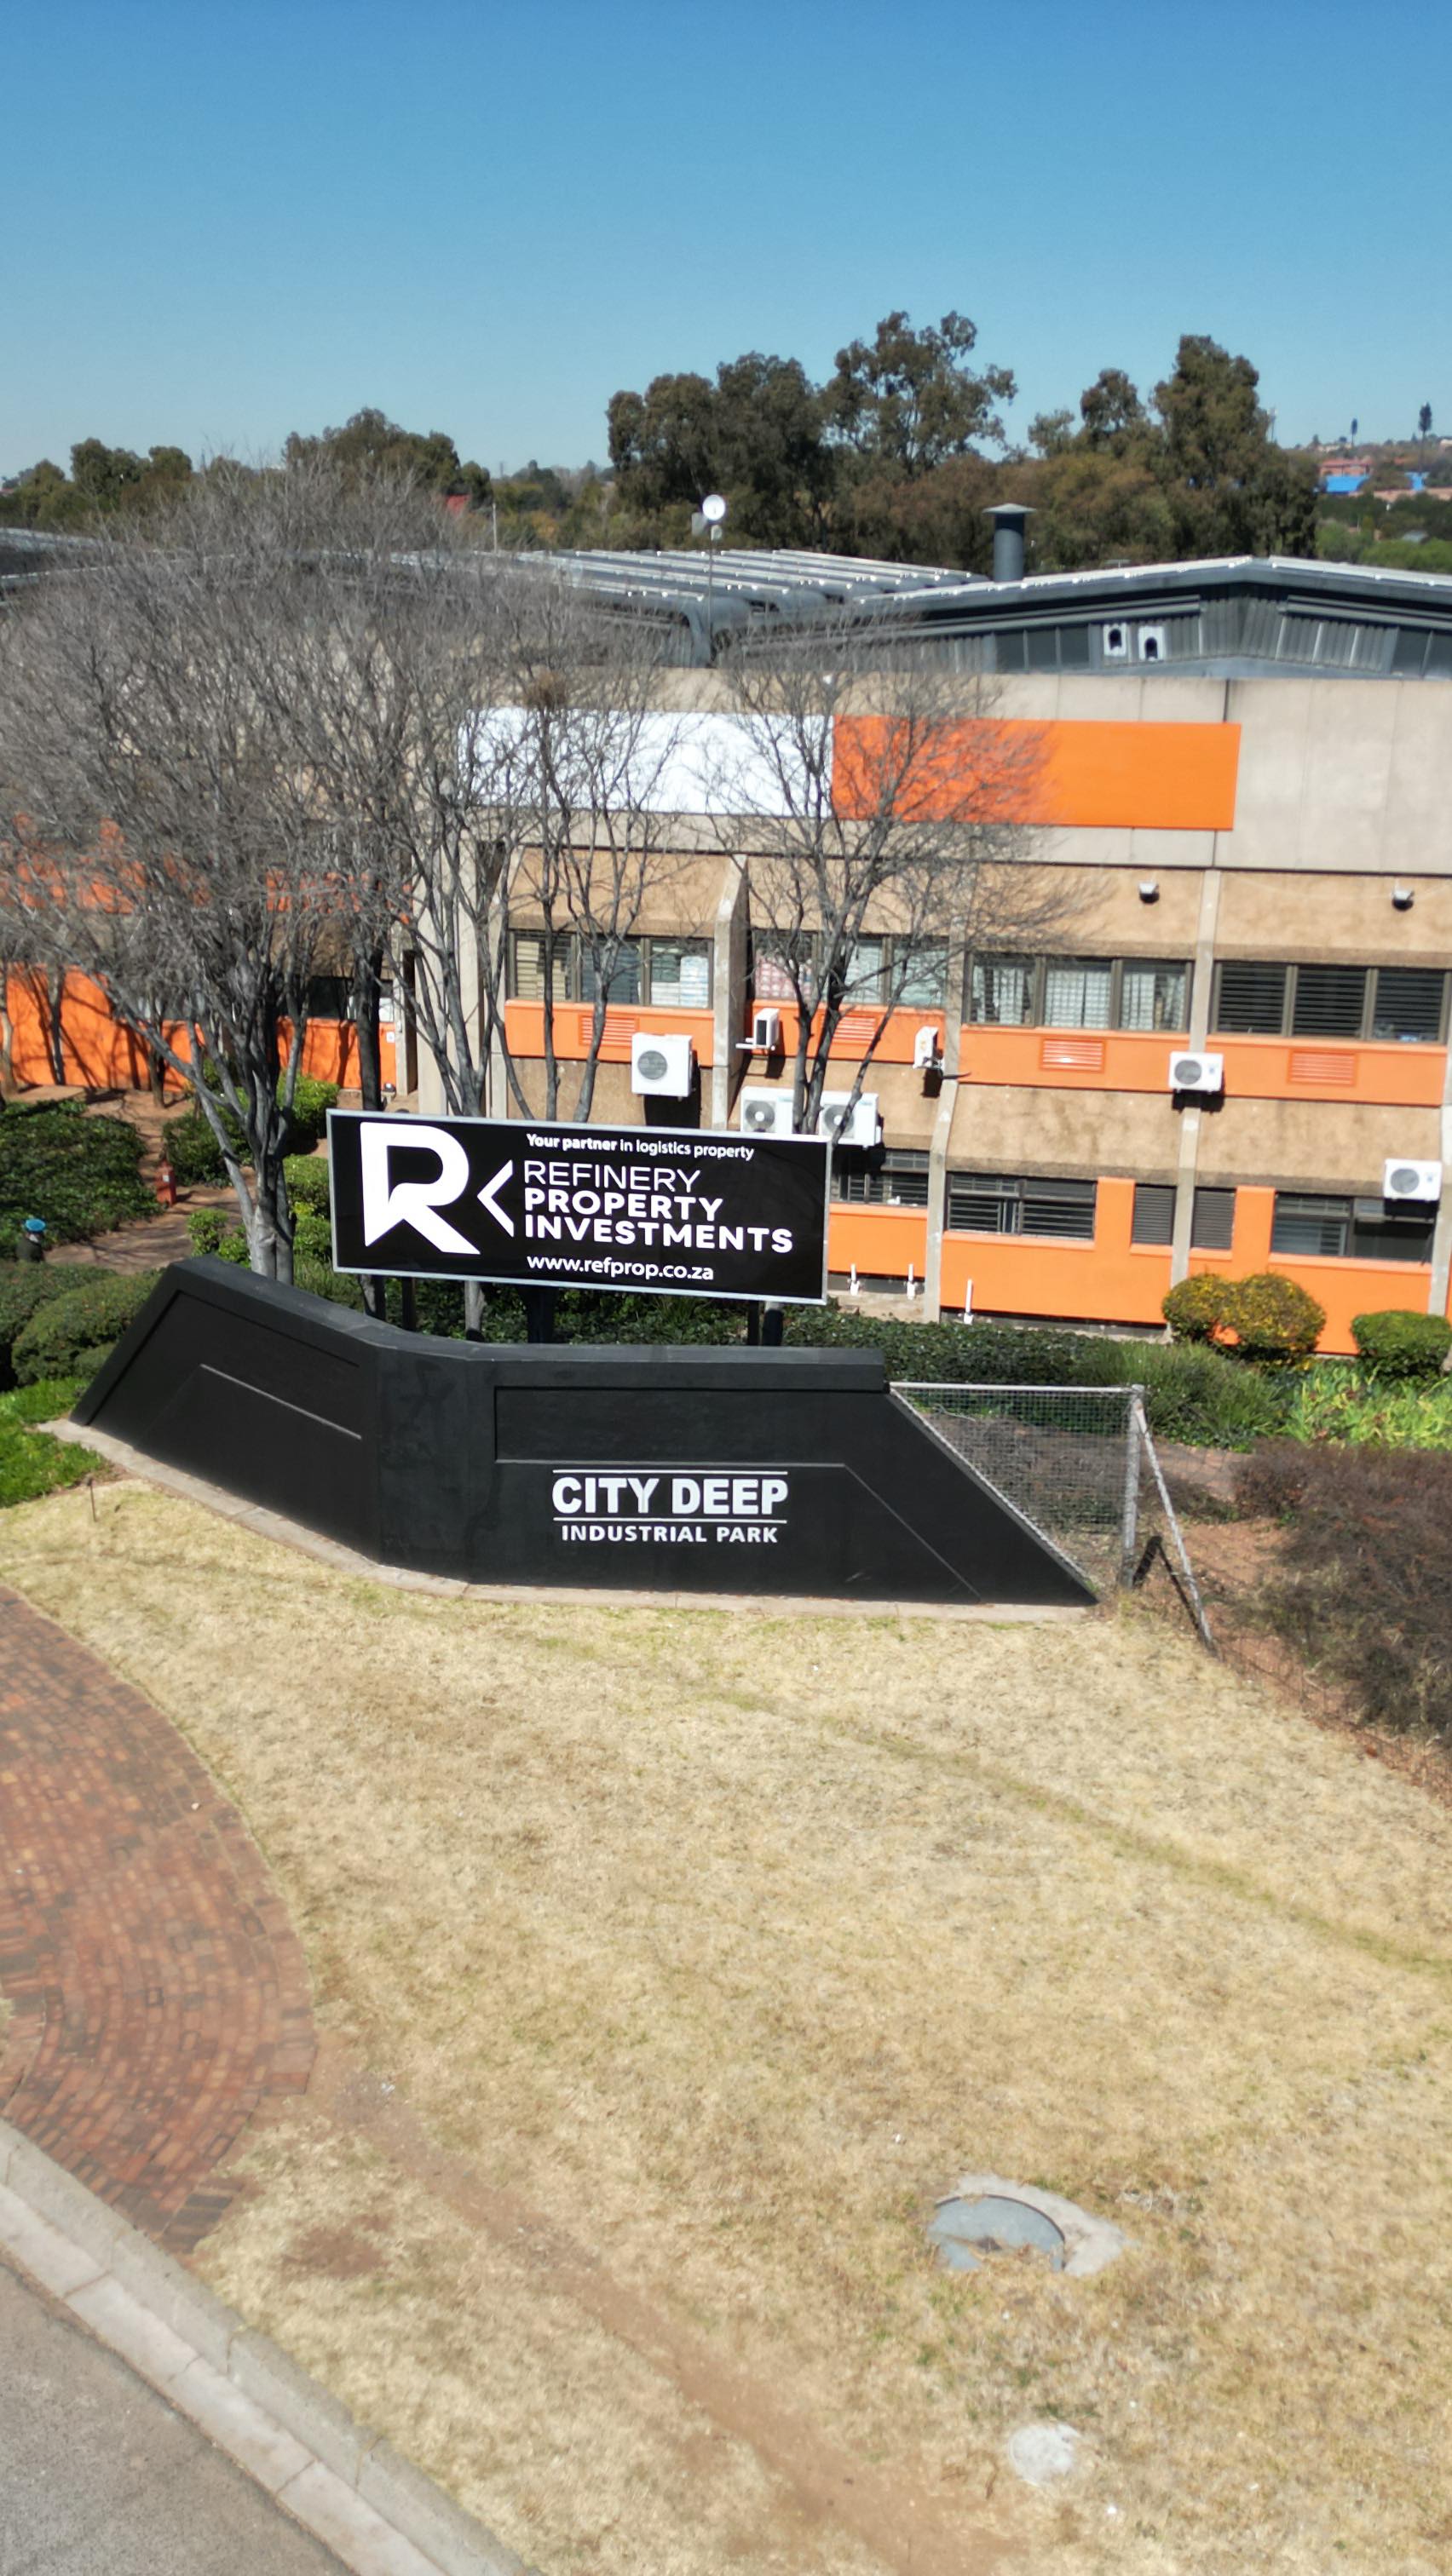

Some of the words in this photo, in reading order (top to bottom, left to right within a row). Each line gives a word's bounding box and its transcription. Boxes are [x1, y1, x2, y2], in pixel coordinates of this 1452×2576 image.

[526, 1133, 561, 1148] Your
[562, 1136, 618, 1152] partner
[619, 1138, 633, 1153] in
[636, 1139, 692, 1157] logistics
[694, 1144, 755, 1162] property
[524, 1159, 701, 1194] REFINERY
[524, 1187, 723, 1222] PROPERTY
[525, 1214, 793, 1253] INVESTMENTS
[527, 1256, 714, 1281] www.refprop.co.za
[552, 1477, 660, 1514] CITY
[671, 1478, 788, 1515] DEEP
[562, 1525, 707, 1543] INDUSTRIAL
[716, 1526, 778, 1544] PARK
